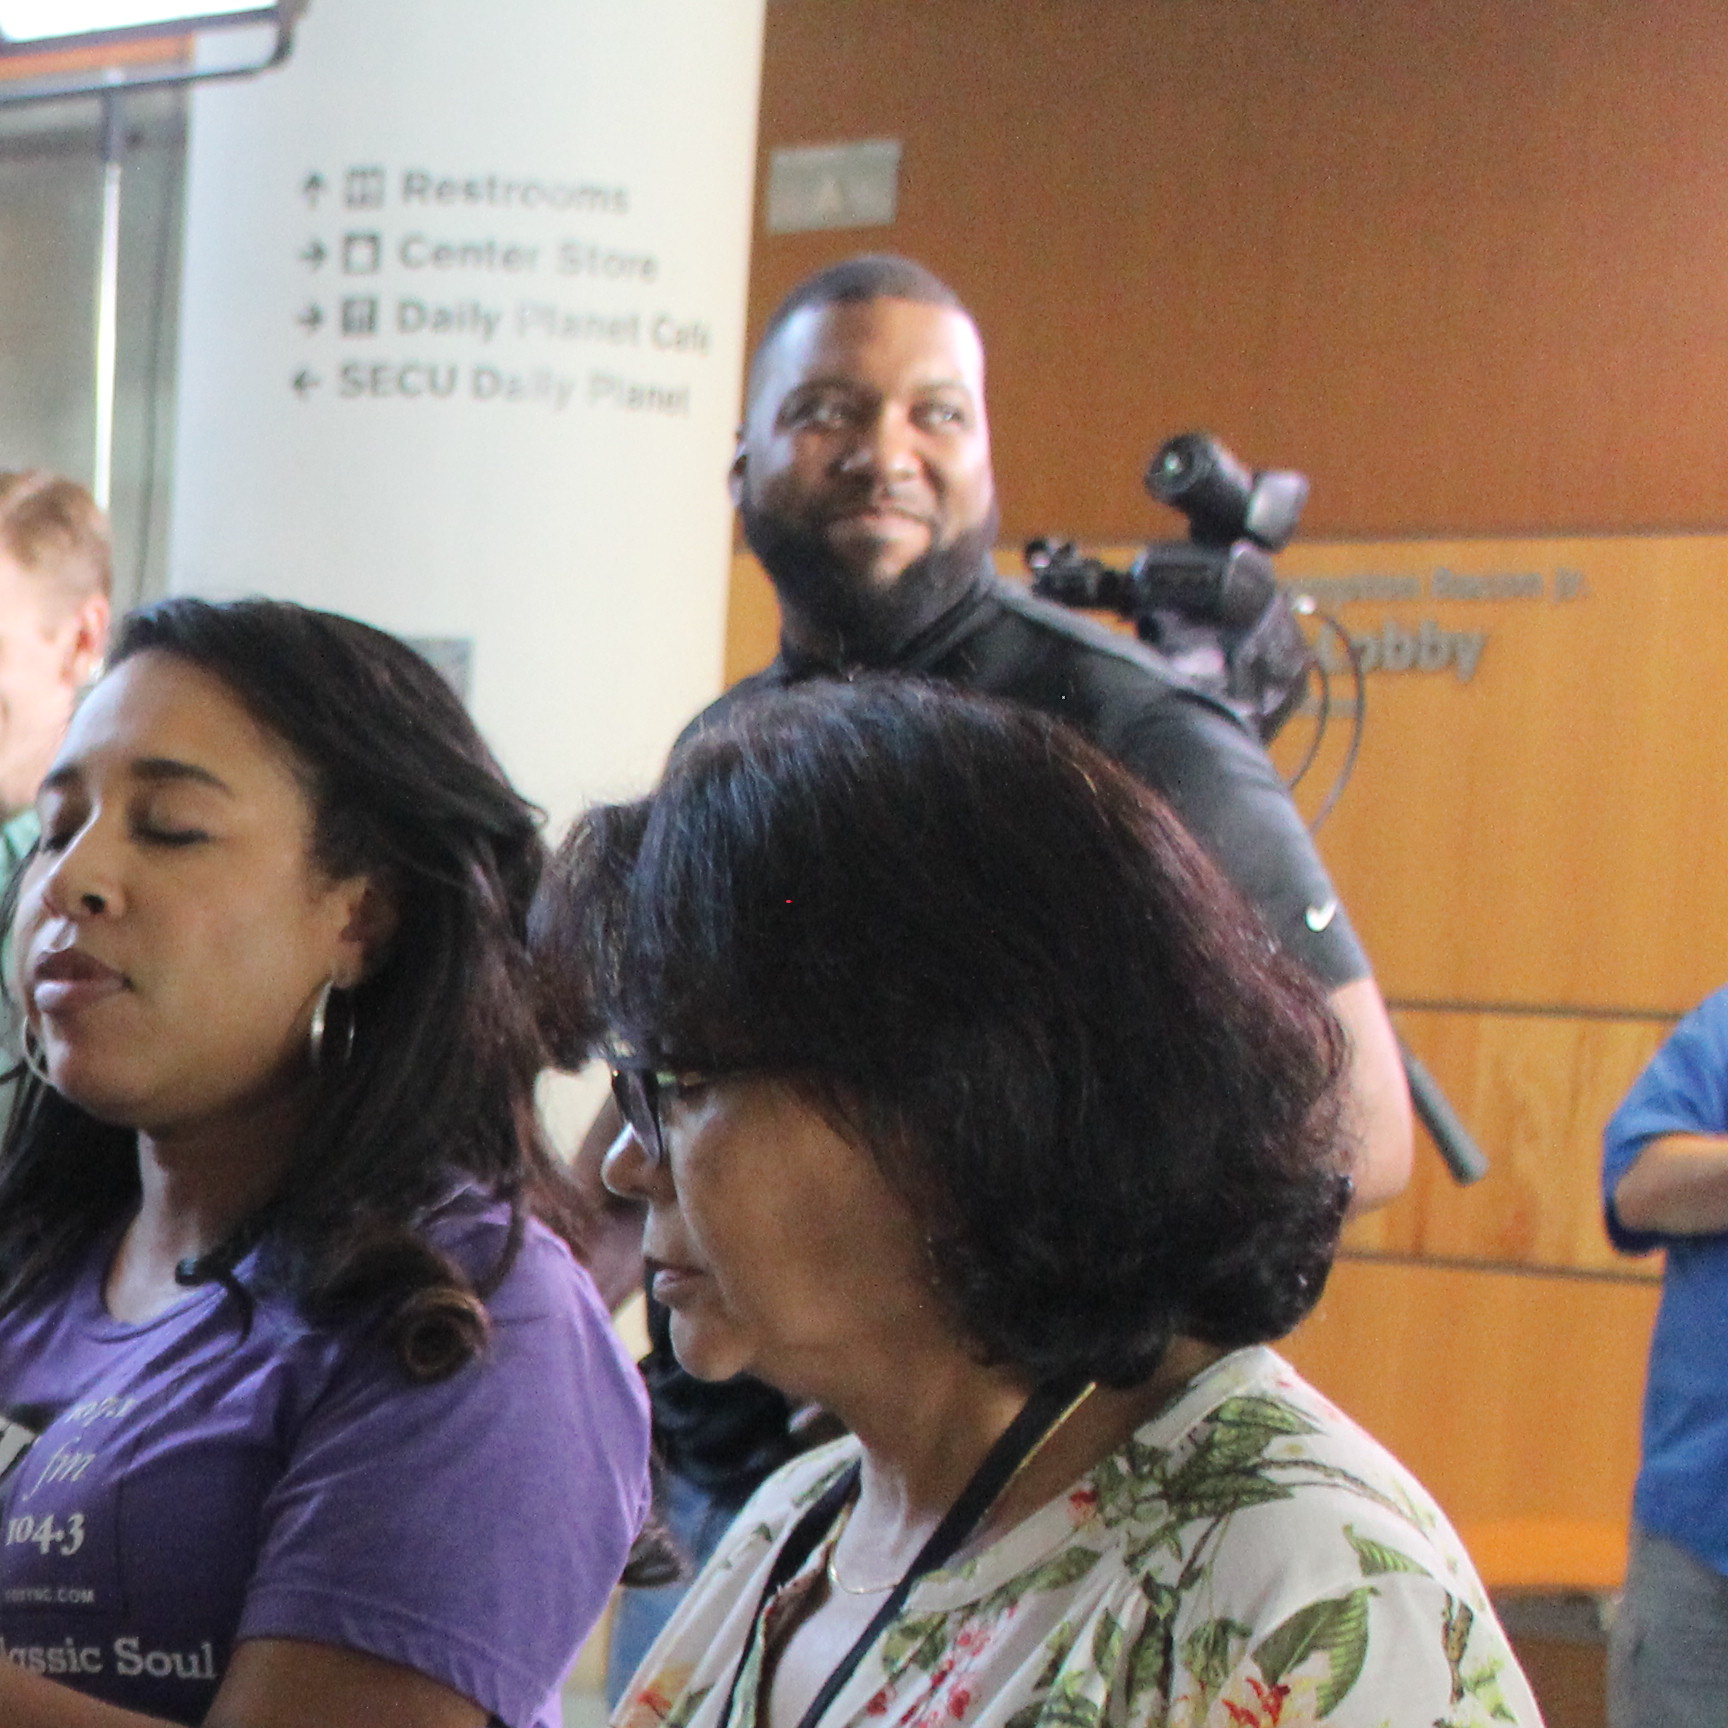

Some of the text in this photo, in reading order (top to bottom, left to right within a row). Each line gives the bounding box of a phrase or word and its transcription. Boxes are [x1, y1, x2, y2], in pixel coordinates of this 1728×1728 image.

[404, 170, 629, 215] Restrooms
[399, 231, 660, 283] Center Store
[398, 298, 501, 344] Daily
[518, 301, 640, 347] Planet
[342, 362, 690, 417] SECU Daily Planet
[1317, 618, 1489, 684] Lobby
[5, 1512, 86, 1556] 104.3
[113, 1636, 218, 1681] Soul
